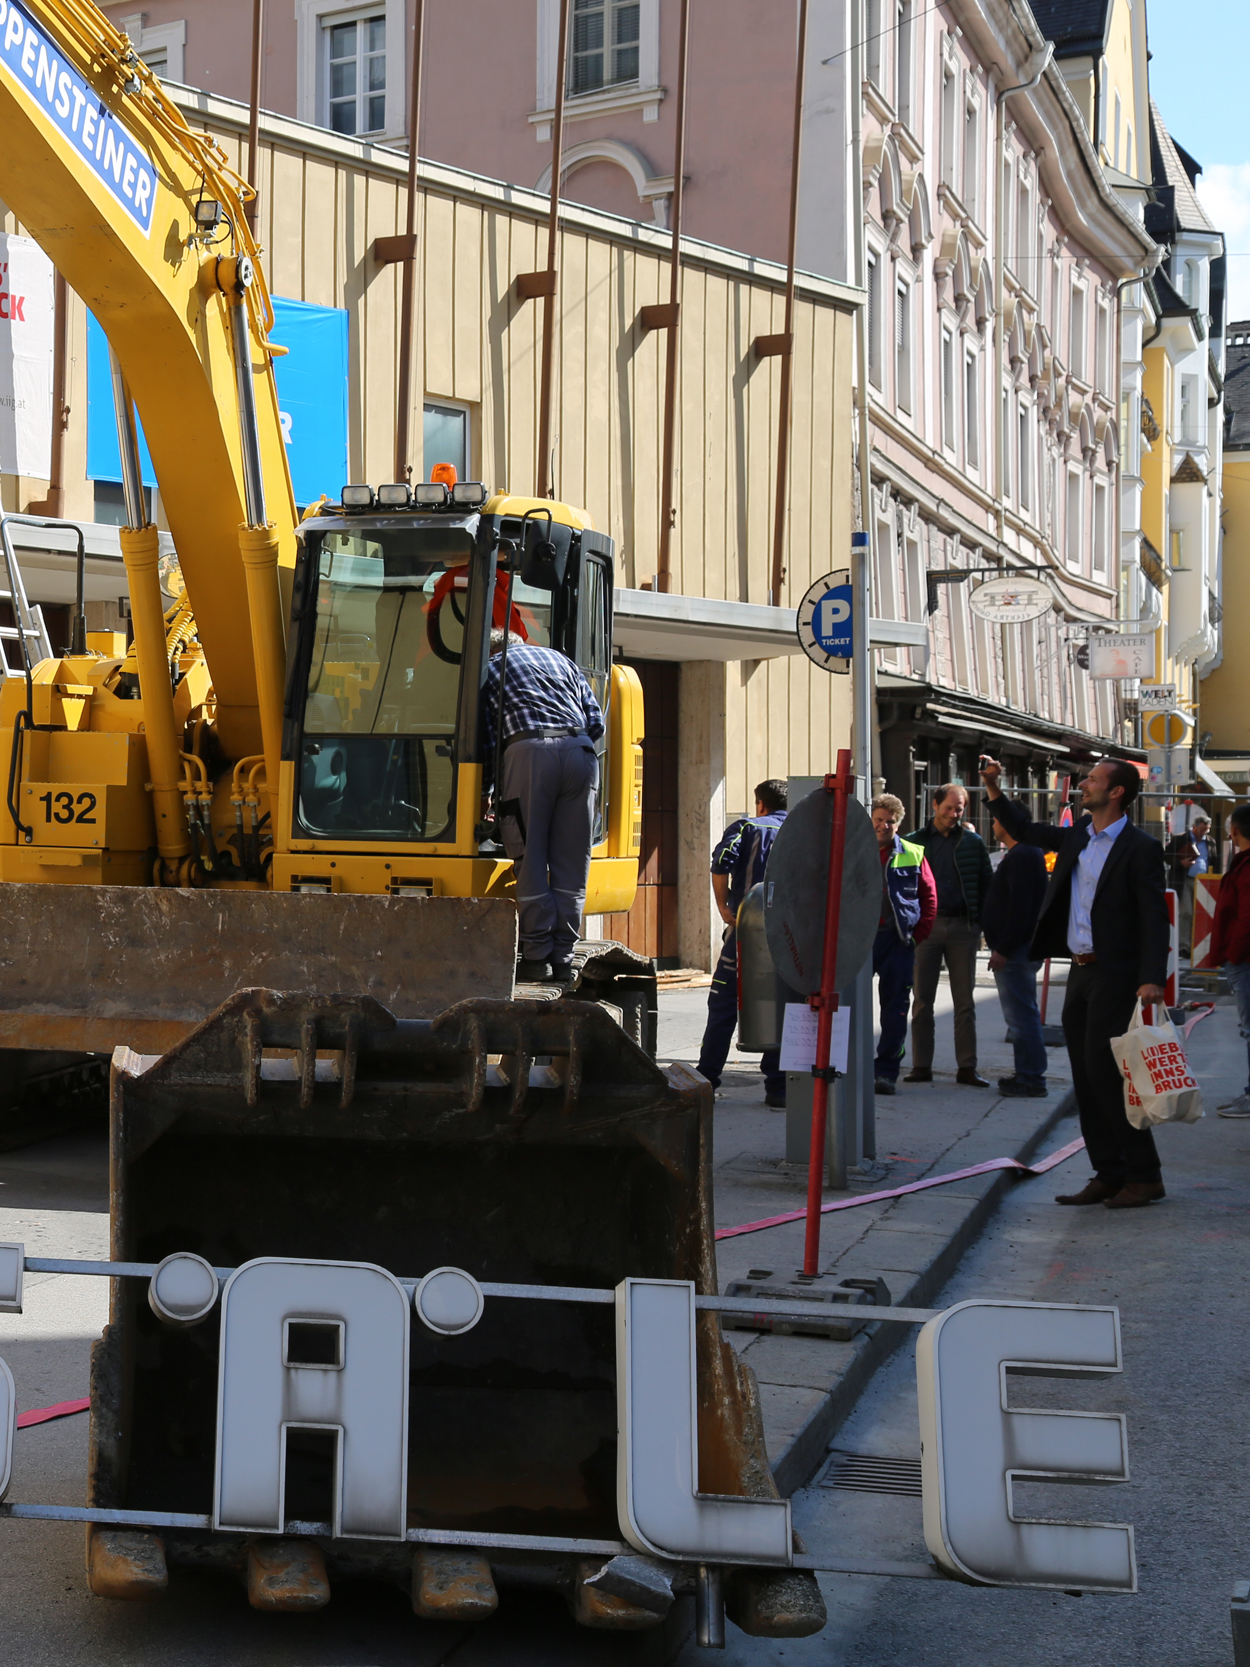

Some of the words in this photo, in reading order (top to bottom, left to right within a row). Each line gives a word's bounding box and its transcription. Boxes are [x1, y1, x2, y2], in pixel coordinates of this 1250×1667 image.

[821, 599, 851, 637] P
[821, 637, 851, 646] TICKET
[1095, 636, 1147, 647] THEATER
[1140, 689, 1174, 699] WELT
[1140, 697, 1174, 706] LADEN
[39, 791, 97, 824] 132
[1146, 1053, 1188, 1072] WERT
[1150, 1065, 1187, 1084] INNS'
[1154, 1076, 1200, 1095] BRUCK
